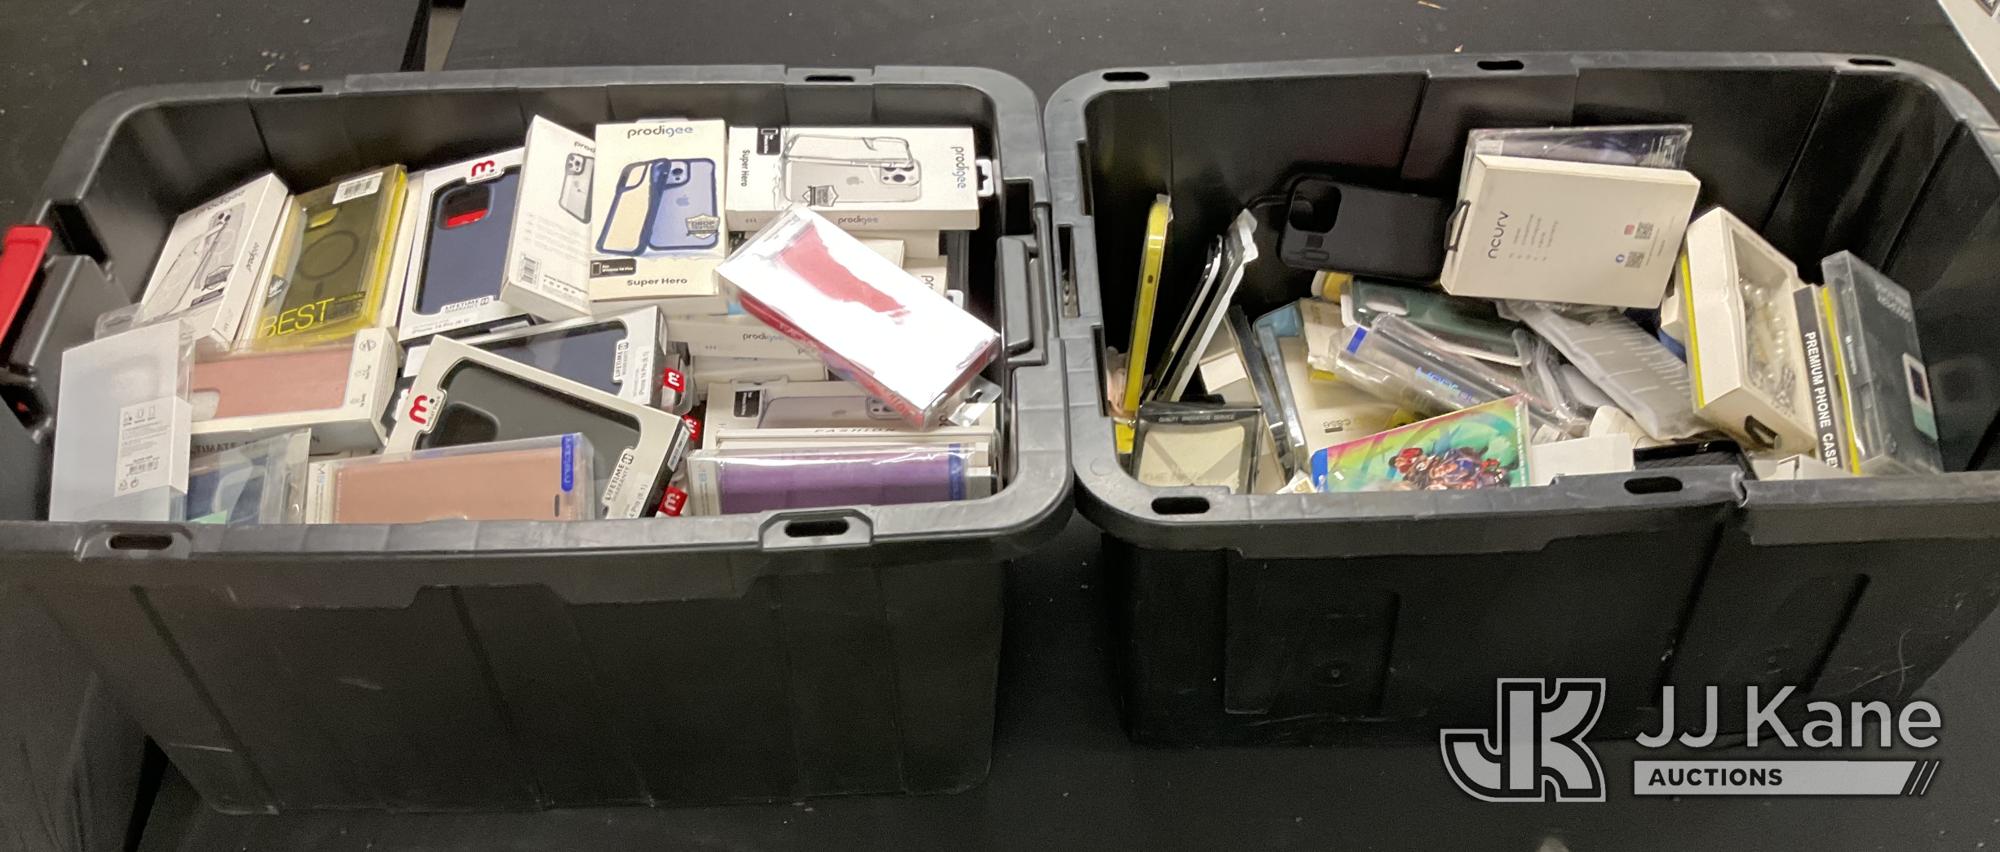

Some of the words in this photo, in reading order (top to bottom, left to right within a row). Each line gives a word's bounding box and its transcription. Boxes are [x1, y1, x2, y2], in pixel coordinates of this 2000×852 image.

[627, 125, 694, 139] prodigee
[740, 149, 750, 169] Super
[950, 145, 966, 190] prodigee
[740, 170, 750, 188] Hero
[837, 215, 880, 225] prodigee
[627, 278, 659, 288] Super
[661, 277, 688, 286] Hero
[260, 298, 335, 338] BEST
[1804, 331, 1824, 385] PREMIUM
[1814, 385, 1832, 428] PHONE
[1822, 432, 1840, 467] CASE
[604, 456, 625, 501] LIFETIME
